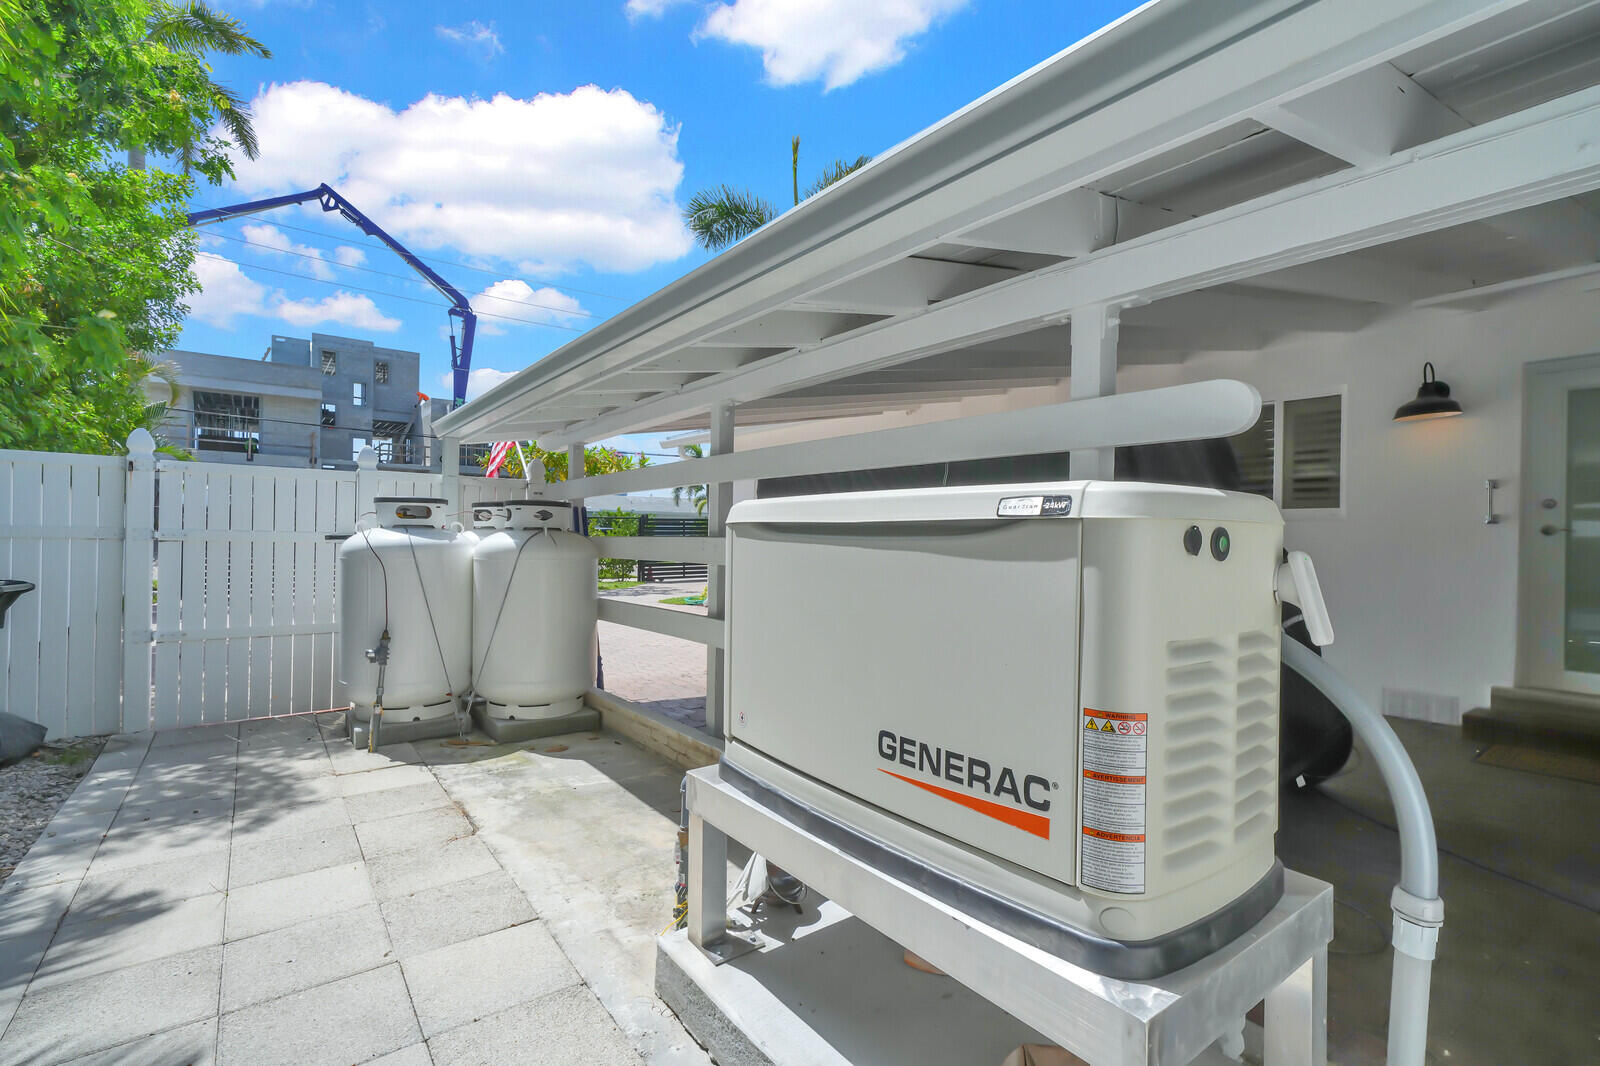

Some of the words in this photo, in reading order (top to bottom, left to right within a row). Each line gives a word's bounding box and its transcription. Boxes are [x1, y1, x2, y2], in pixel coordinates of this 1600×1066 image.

[877, 729, 1050, 812] GENERAC
[1093, 773, 1145, 782] AVERTISSEMENT
[1096, 831, 1140, 841] ADVERTENCIA
